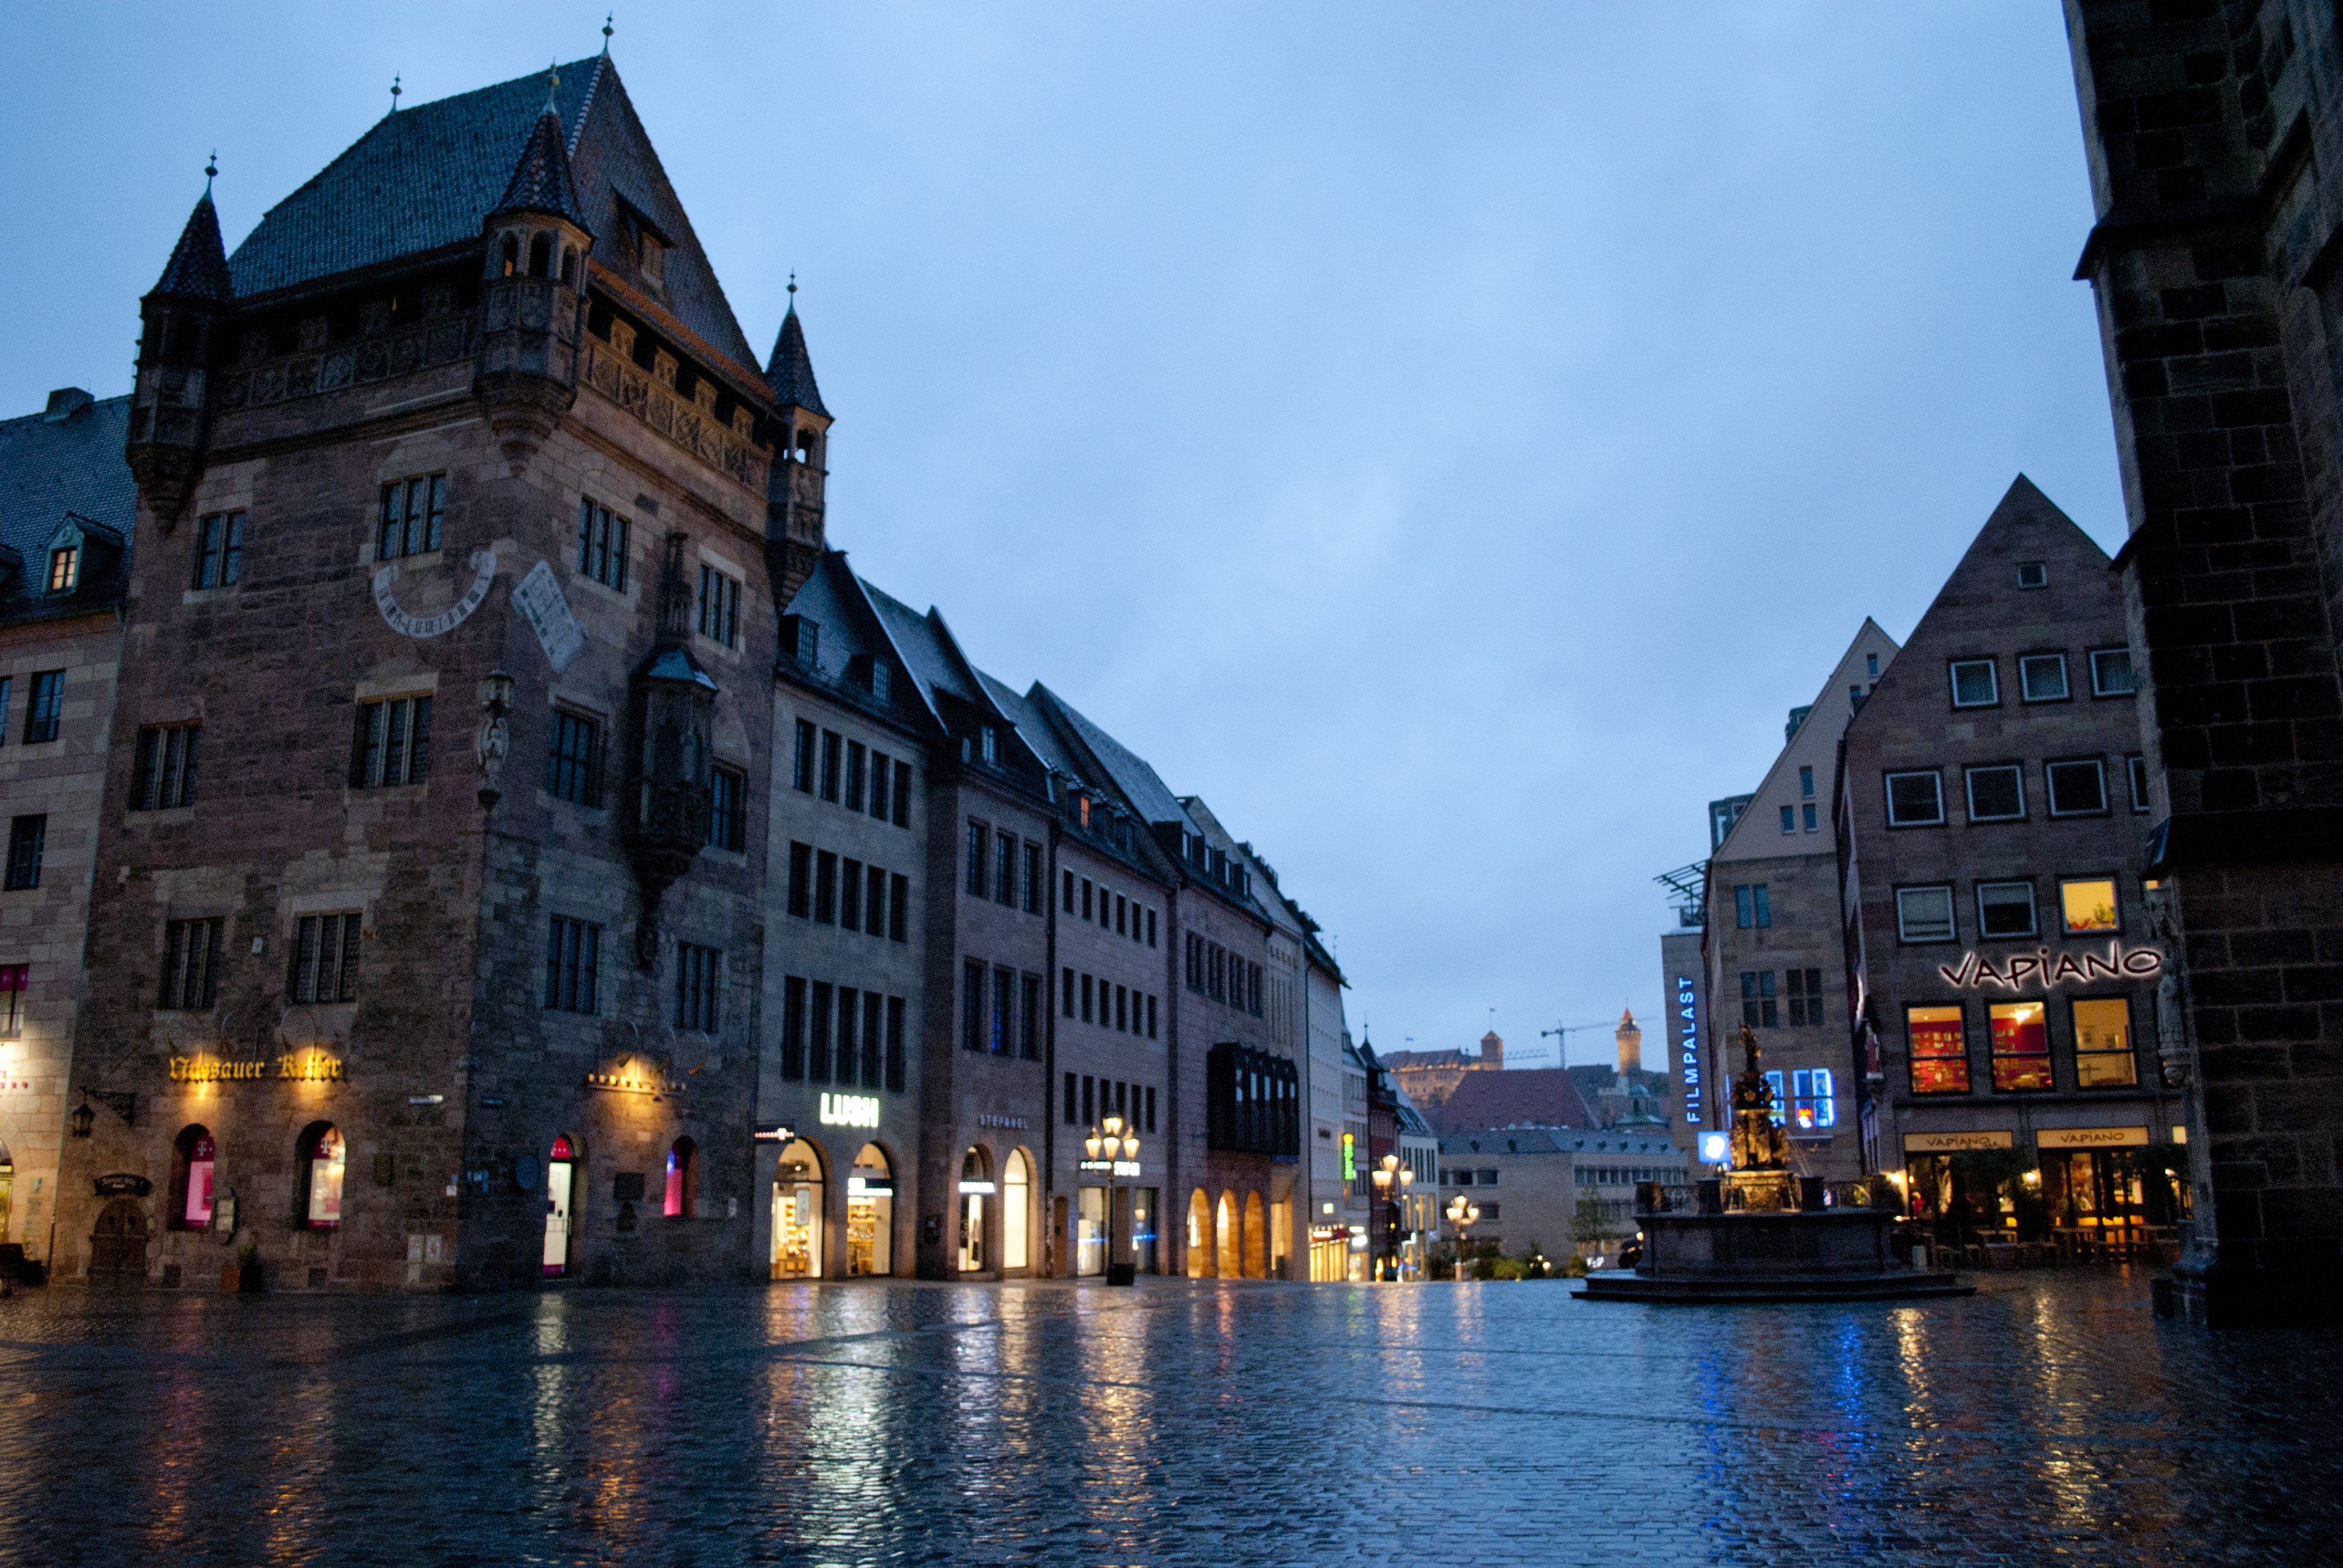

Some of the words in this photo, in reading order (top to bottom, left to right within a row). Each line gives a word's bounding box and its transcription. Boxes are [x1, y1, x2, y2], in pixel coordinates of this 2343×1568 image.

[1679, 977, 1701, 1123] FILMPALAST
[169, 1056, 264, 1080] Nassauer
[820, 1093, 879, 1128] LUSH
